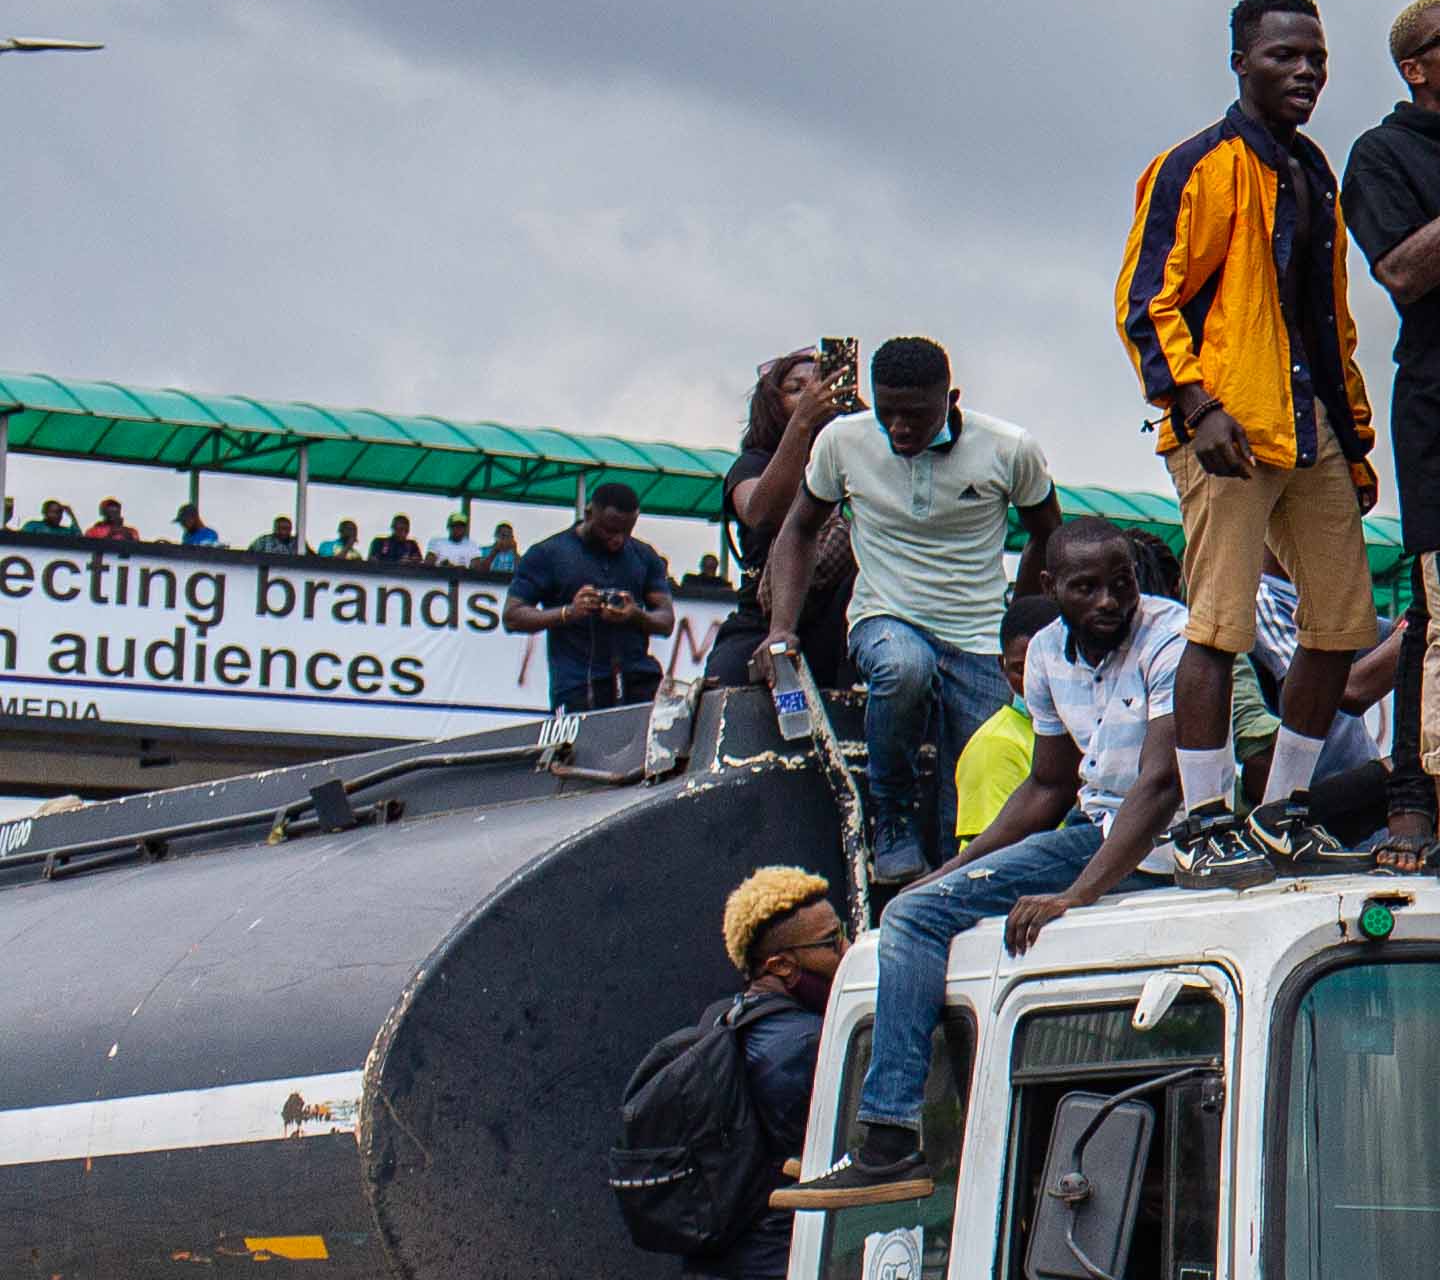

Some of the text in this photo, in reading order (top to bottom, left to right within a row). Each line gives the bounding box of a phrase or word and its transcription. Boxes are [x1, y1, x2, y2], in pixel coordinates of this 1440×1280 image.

[0, 549, 501, 633] ecting brands
[48, 627, 425, 696] audiences
[0, 697, 101, 720] MEDIA
